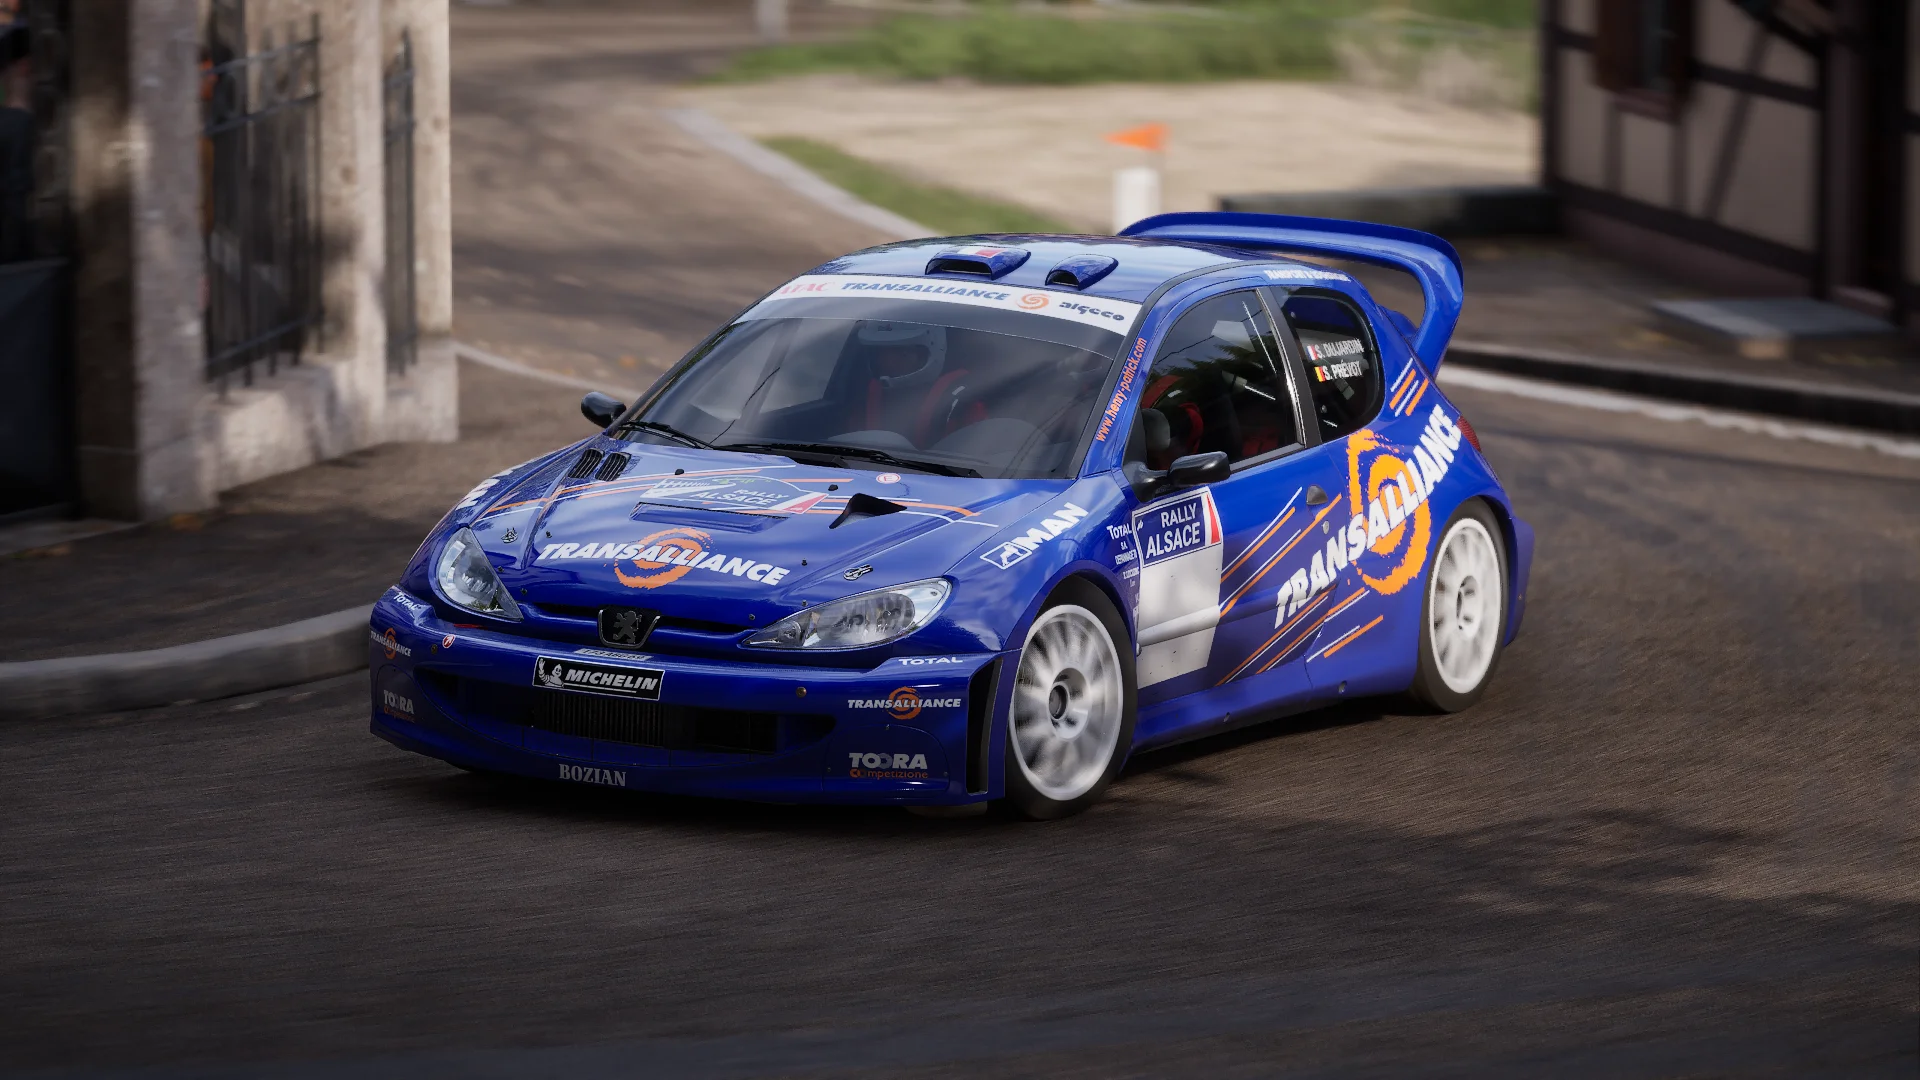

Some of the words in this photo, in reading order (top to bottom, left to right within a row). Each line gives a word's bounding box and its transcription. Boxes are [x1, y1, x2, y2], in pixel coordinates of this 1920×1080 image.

[841, 282, 1011, 301] TRANSALLIANCE
[1322, 338, 1364, 358] DUJARDIN
[1322, 365, 1333, 380] S.
[1096, 338, 1147, 442] www.henry-patrick.com
[690, 491, 778, 505] ALSACE
[733, 489, 789, 499] RALLY
[1013, 502, 1089, 551] MAN
[1161, 502, 1197, 529] RALLY
[1274, 404, 1462, 629] TRANSALLIANCE
[1145, 521, 1201, 560] ALSACE
[537, 543, 790, 586] TRANSALLIANCE
[370, 630, 412, 657] TRANSALLIANCE
[898, 656, 963, 666] TOTAL
[565, 668, 659, 691] MICHELIN
[848, 698, 961, 709] TRANSALLIANCE
[848, 752, 928, 770] TOORA
[558, 764, 626, 787] BOZIAN
